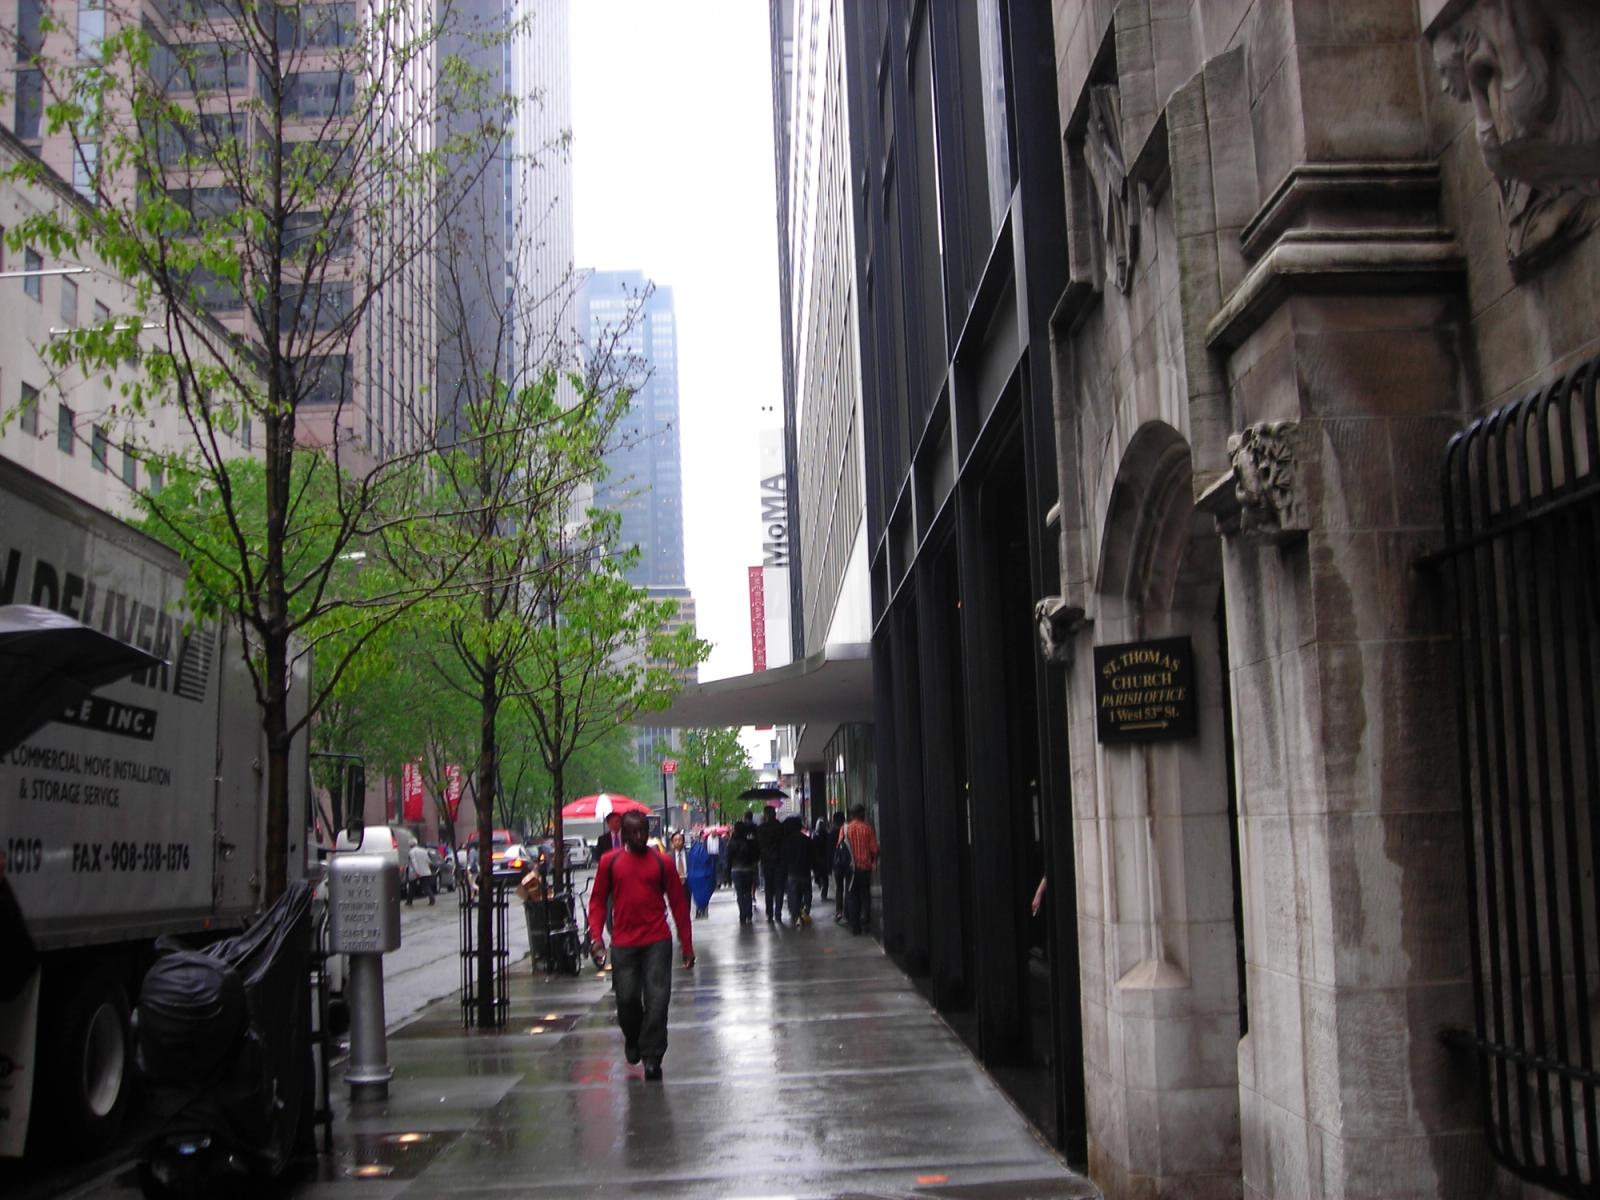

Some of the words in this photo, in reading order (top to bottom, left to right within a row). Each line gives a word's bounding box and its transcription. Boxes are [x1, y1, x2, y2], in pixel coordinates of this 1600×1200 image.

[761, 473, 789, 567] MoMA
[1120, 650, 1180, 672] THOMAS
[1112, 672, 1171, 690] CHURCH
[1102, 691, 1142, 707] PARISH
[1144, 687, 1185, 704] OFFICE
[106, 706, 153, 734] INC.
[11, 744, 81, 774] COMMERCIAL
[84, 754, 110, 778] MOVE
[113, 759, 171, 787] INSTALLATION
[32, 778, 81, 804] STORAGE
[84, 783, 120, 808] SERVICE
